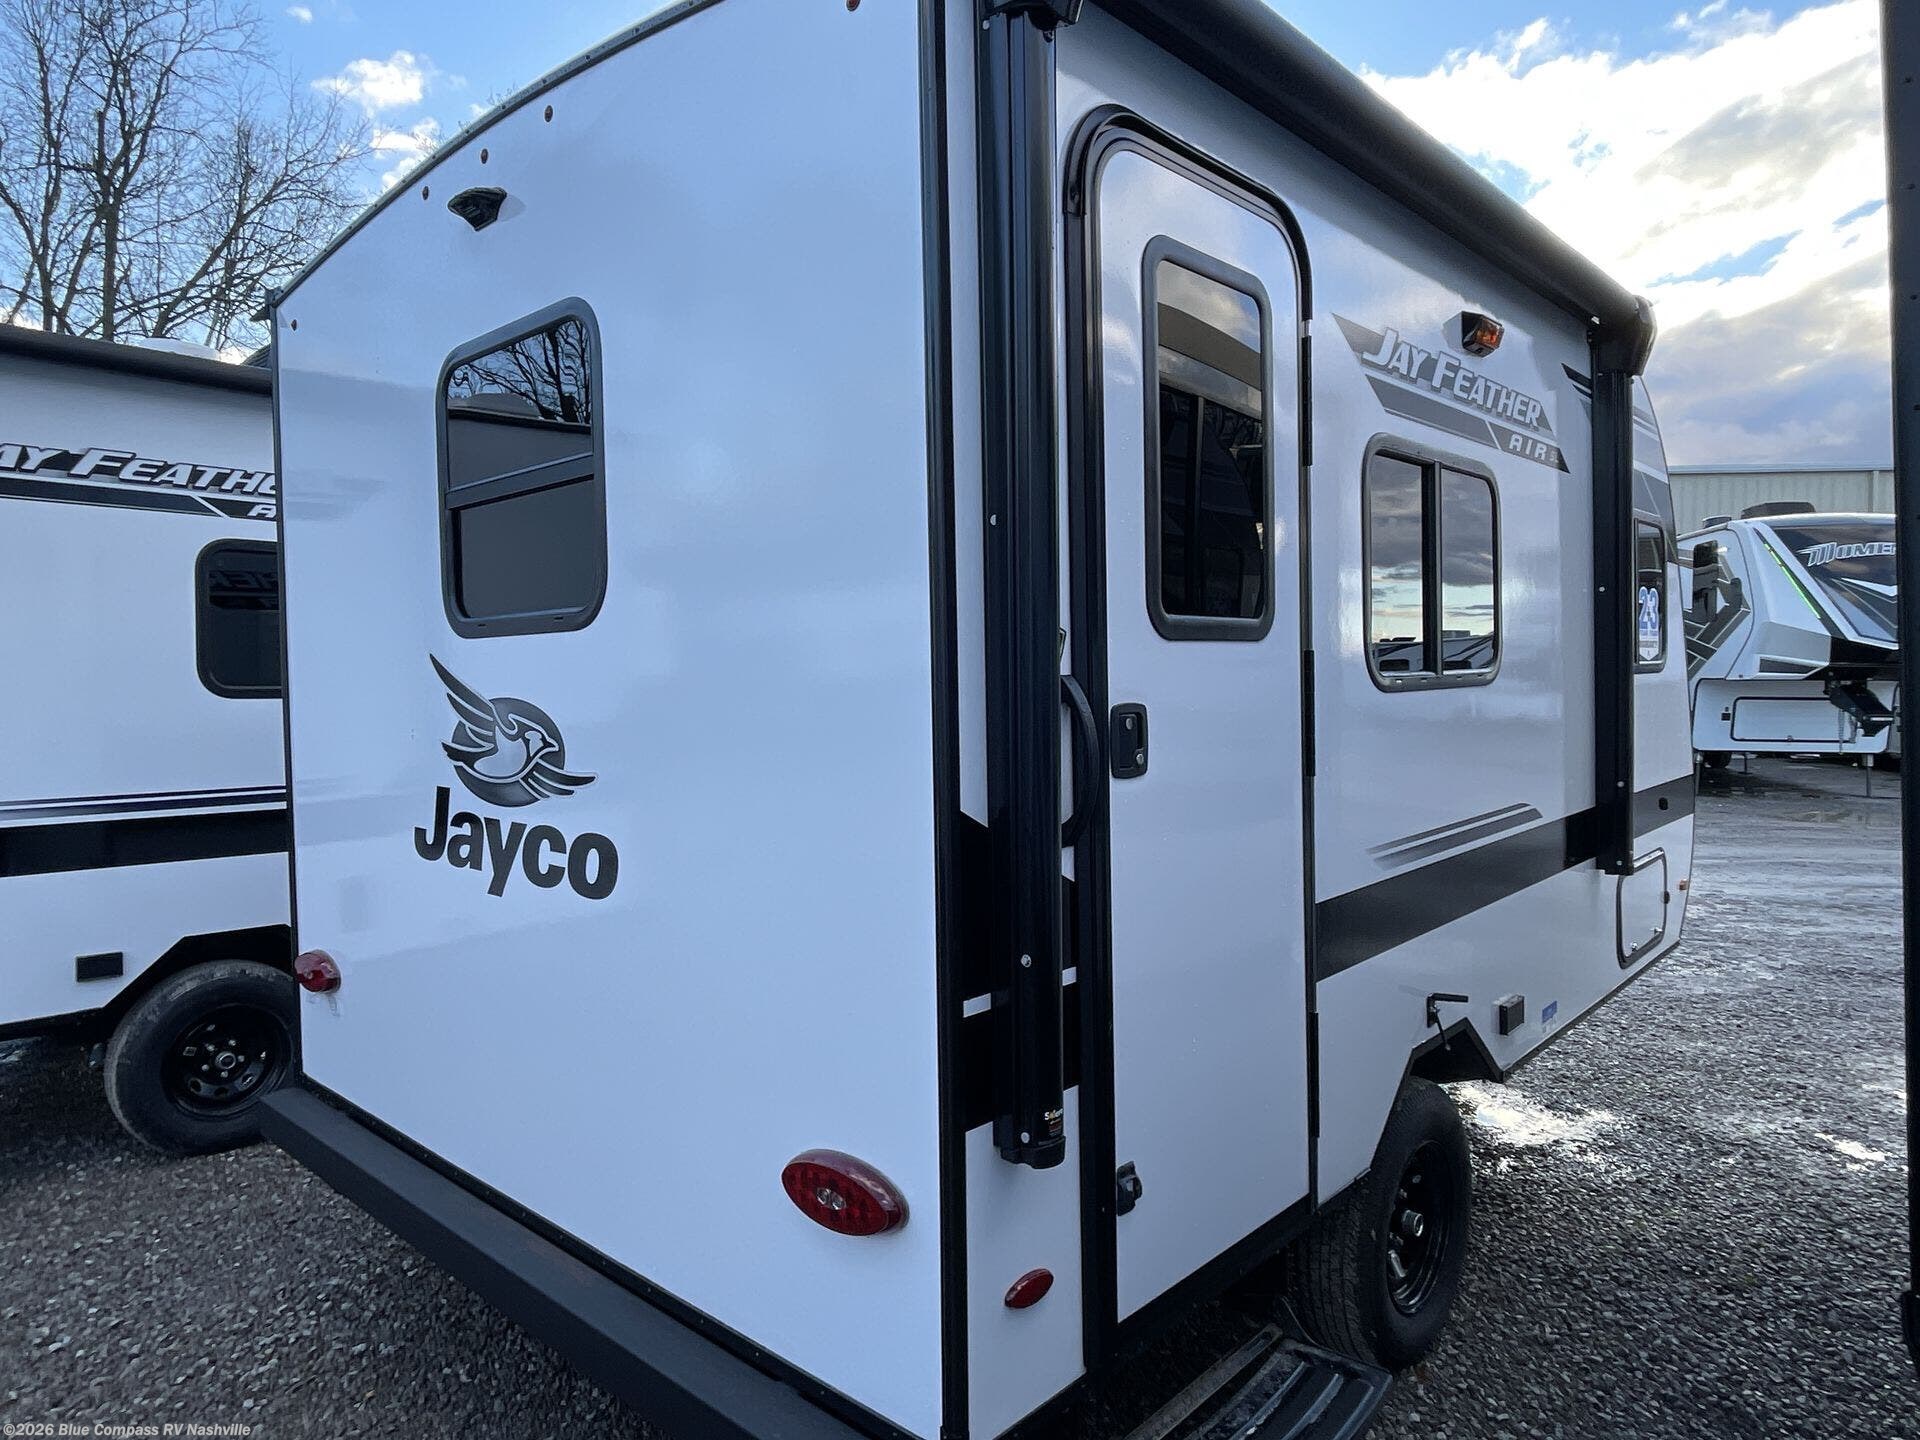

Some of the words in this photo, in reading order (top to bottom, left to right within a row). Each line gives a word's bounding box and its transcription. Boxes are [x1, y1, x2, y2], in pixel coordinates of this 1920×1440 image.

[1361, 327, 1429, 378] JAY
[1432, 352, 1541, 427] FEATHER
[1509, 433, 1547, 461] AIR
[414, 786, 618, 900] Jayco
